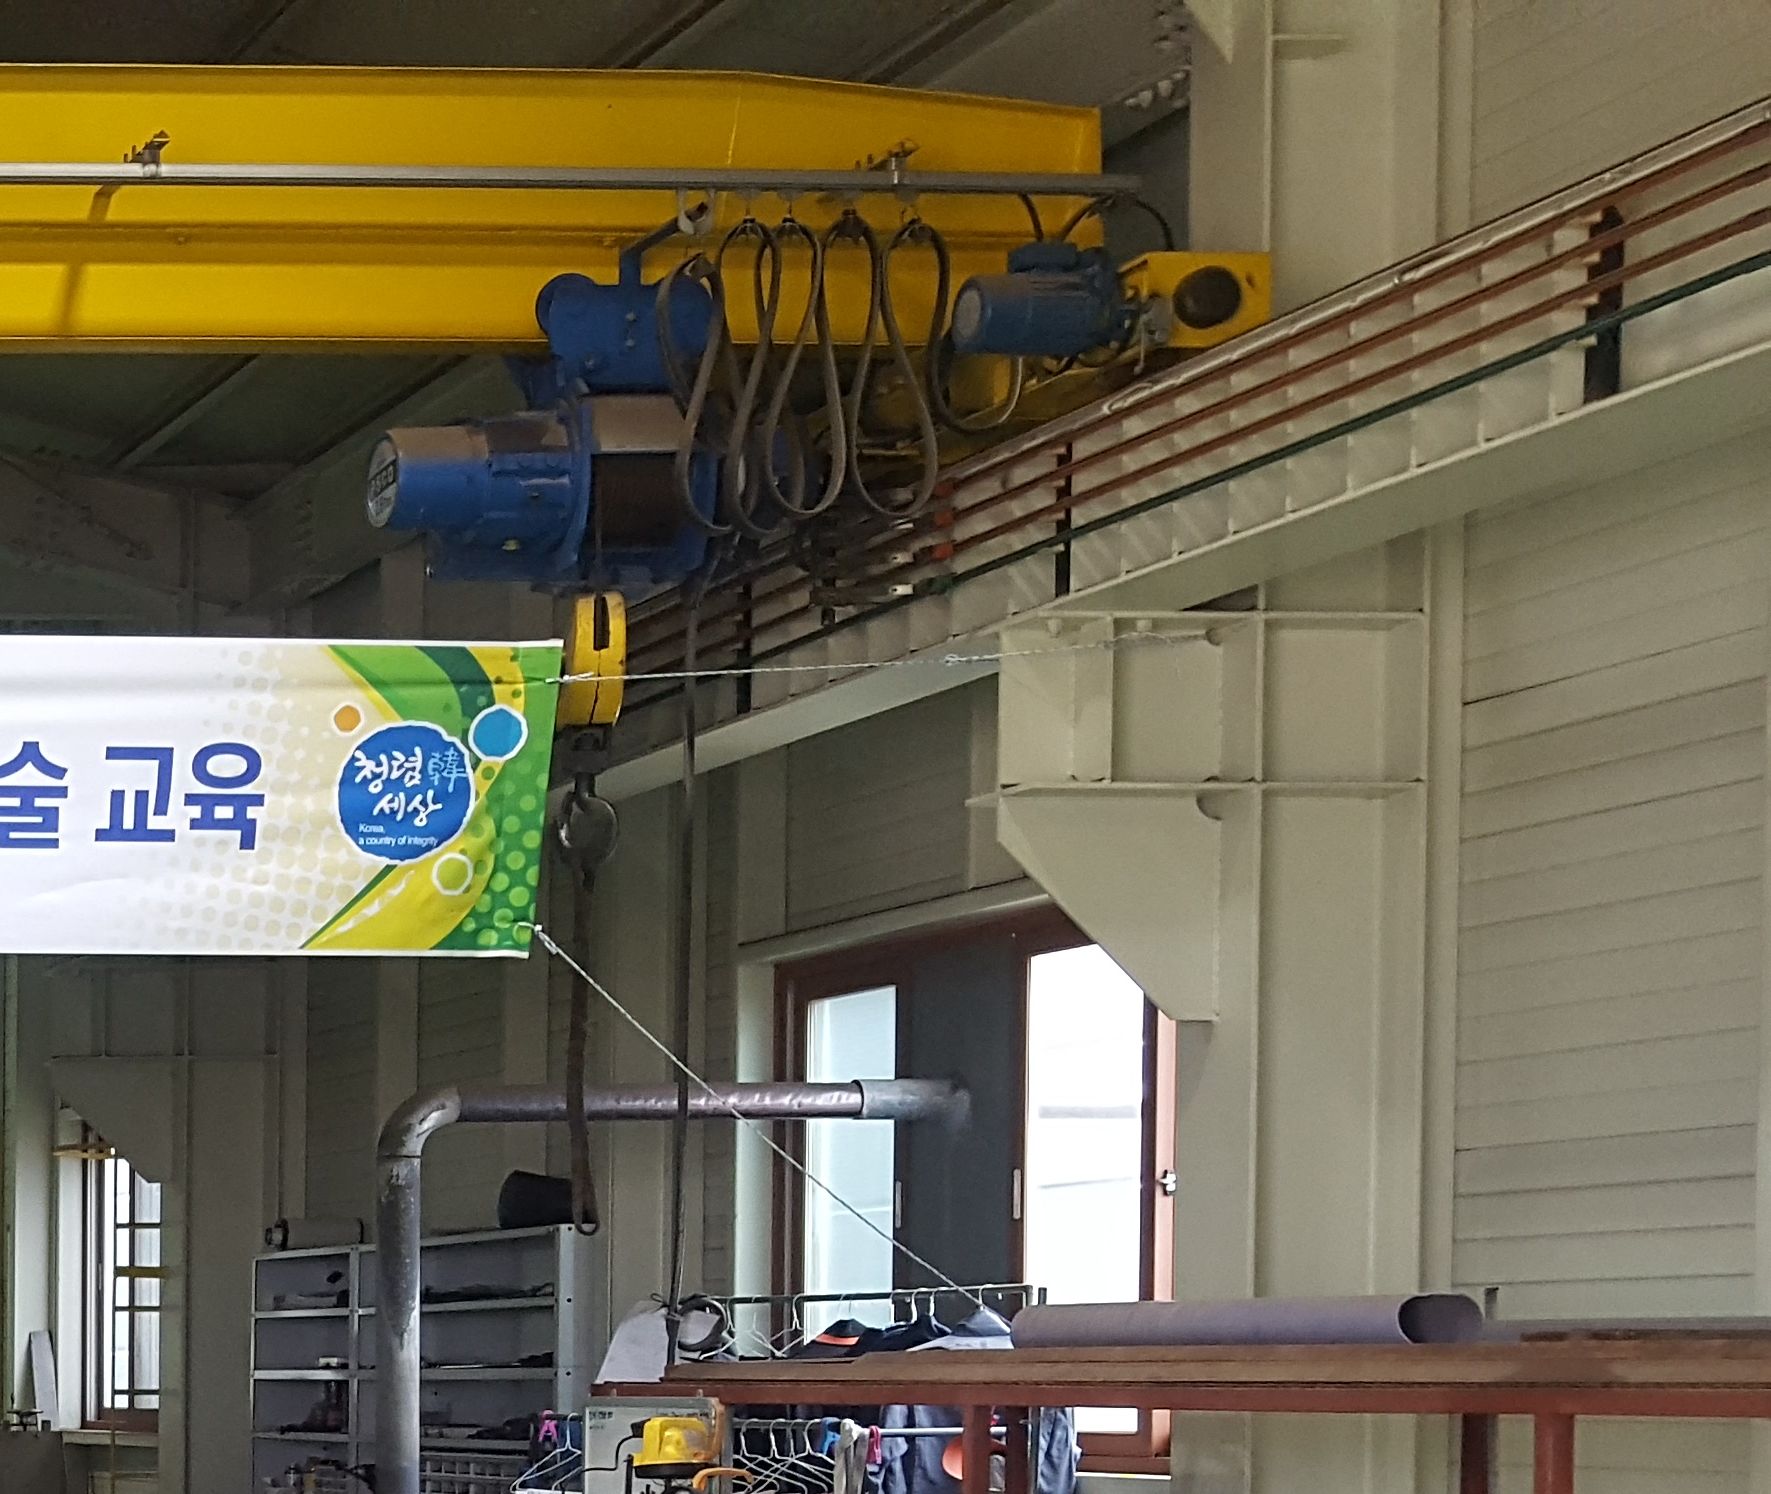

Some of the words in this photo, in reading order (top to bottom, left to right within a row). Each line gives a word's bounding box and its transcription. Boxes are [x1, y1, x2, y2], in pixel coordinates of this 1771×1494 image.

[353, 746, 424, 794] 청렴
[94, 741, 266, 851] 교육
[372, 789, 443, 827] 세상
[365, 836, 396, 847] country
[398, 836, 408, 846] of
